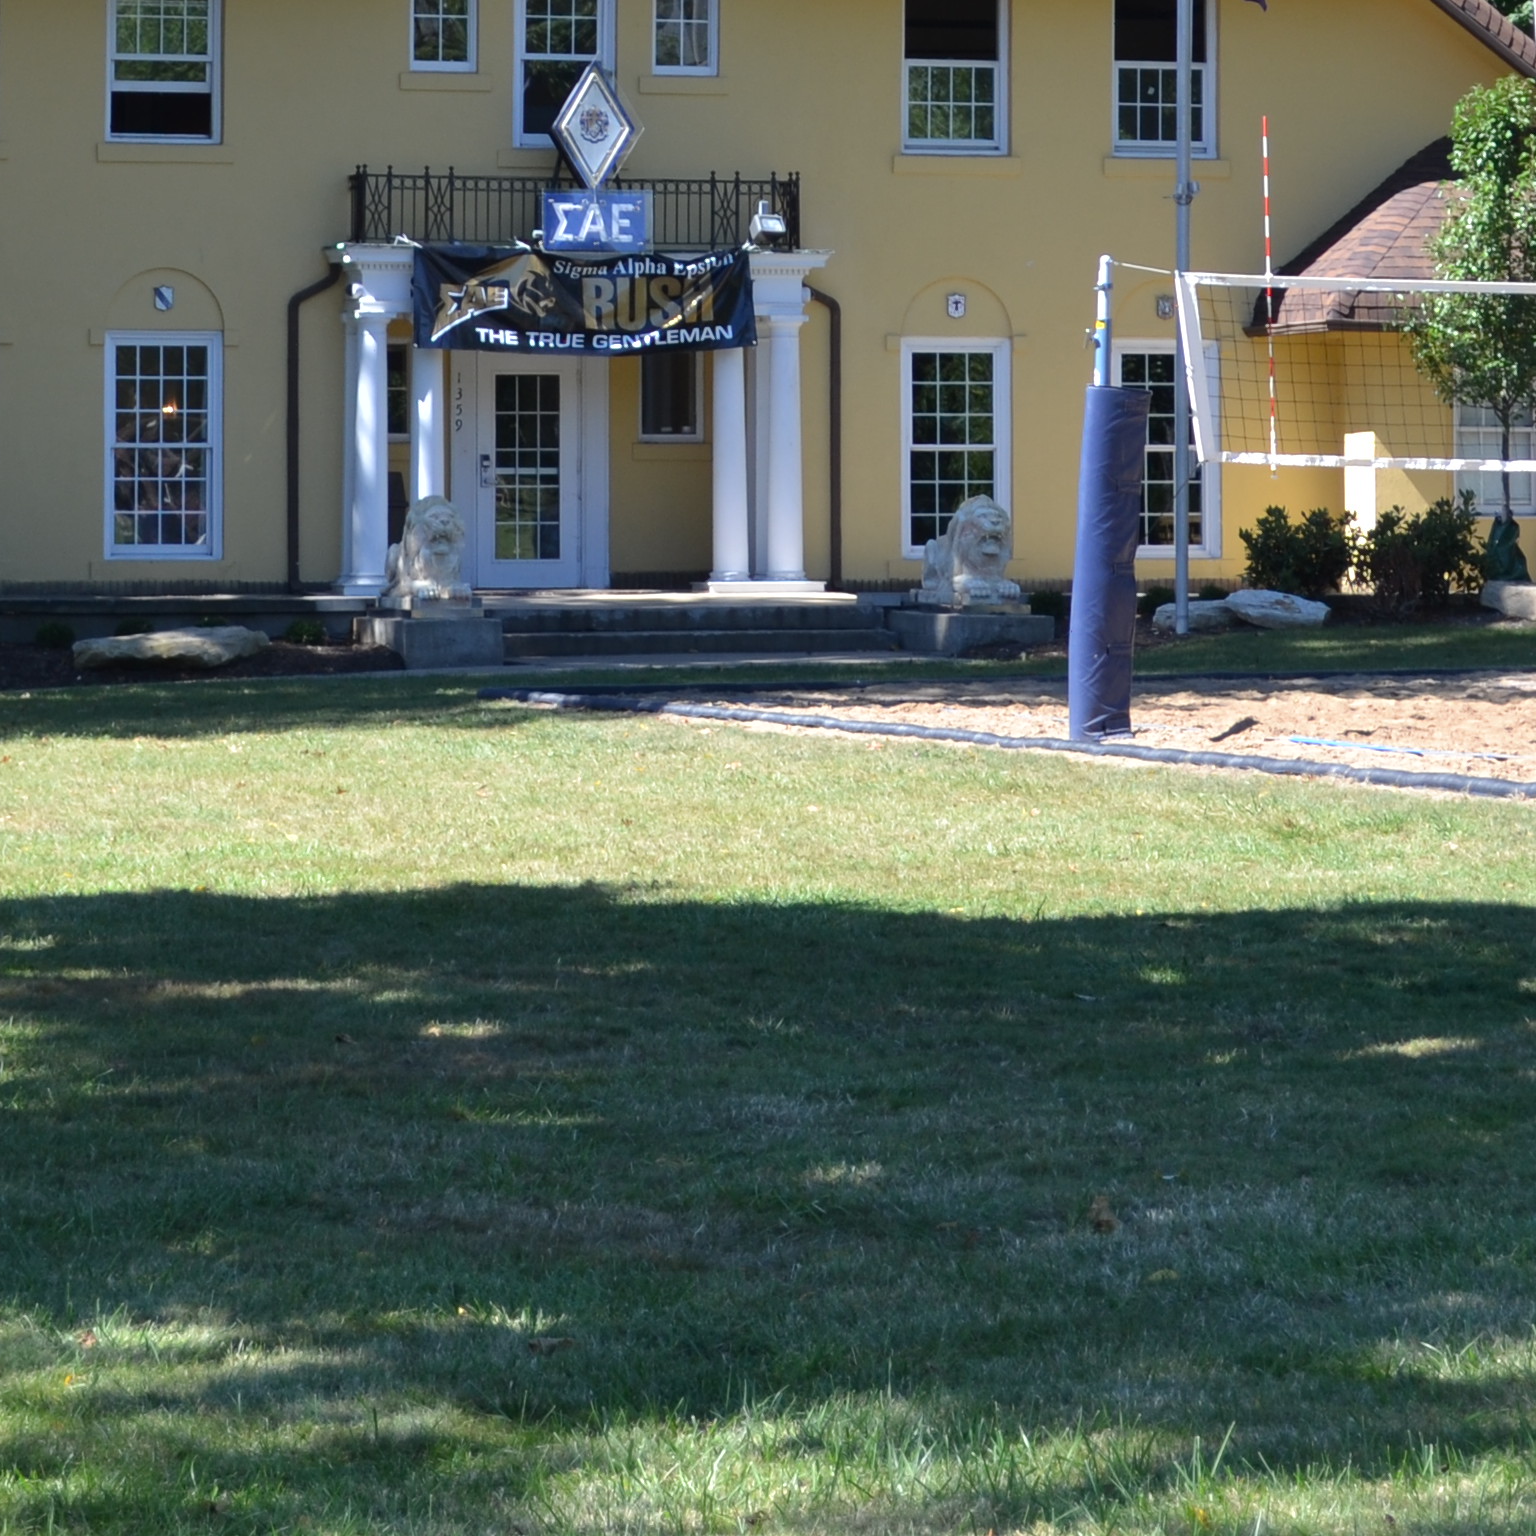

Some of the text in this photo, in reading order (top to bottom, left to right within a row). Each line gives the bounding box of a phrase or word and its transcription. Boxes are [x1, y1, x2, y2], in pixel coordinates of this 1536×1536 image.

[553, 260, 608, 279] Sigma
[612, 258, 667, 279] Alpha
[581, 276, 714, 331] RUSH
[475, 324, 733, 350] THE TRUE GENTLEMAN
[454, 371, 463, 432] 1359
